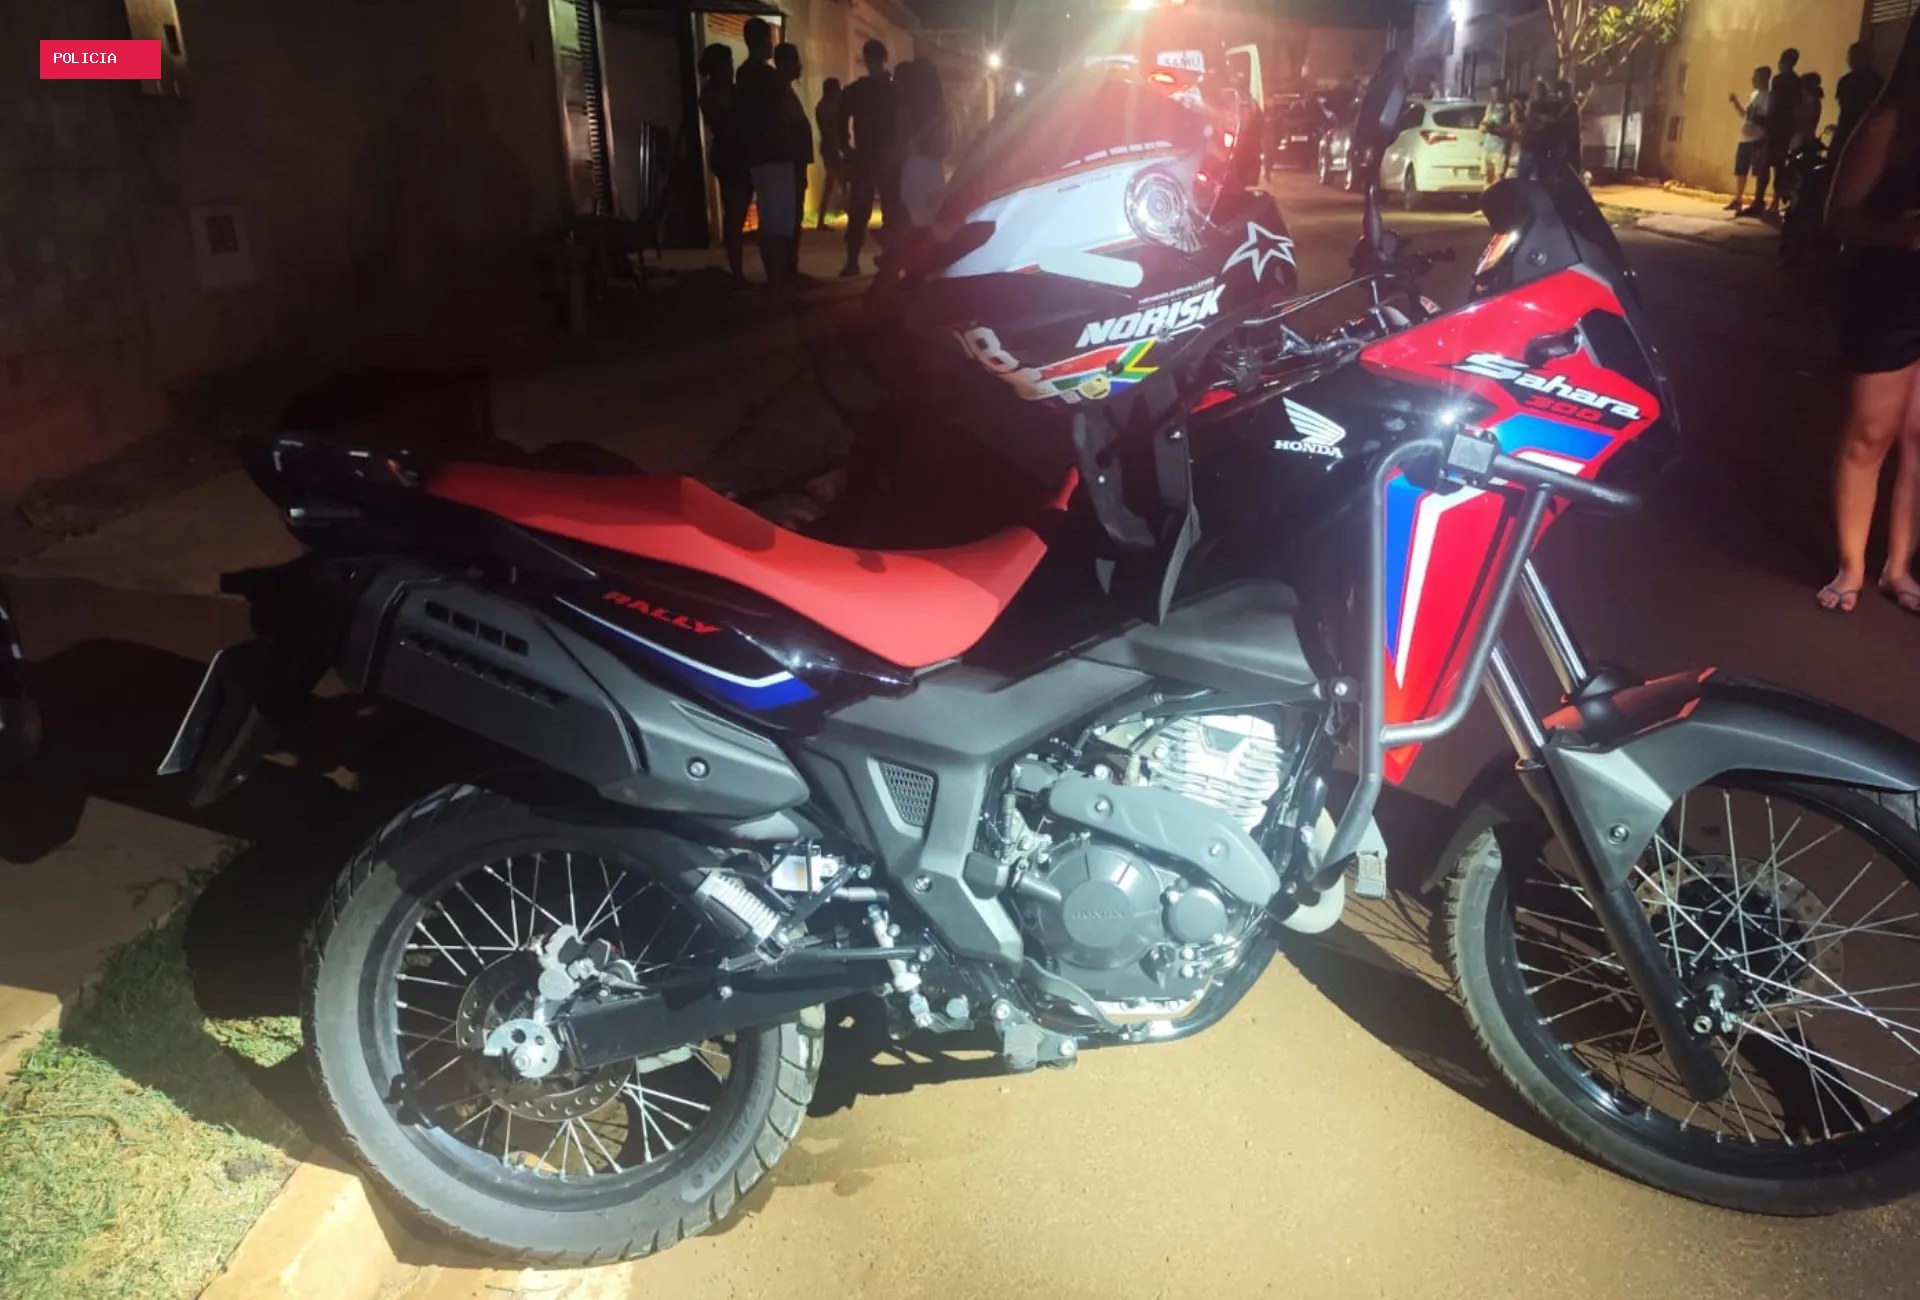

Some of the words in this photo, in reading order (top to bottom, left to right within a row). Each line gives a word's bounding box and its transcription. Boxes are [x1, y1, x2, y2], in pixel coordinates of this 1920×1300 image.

[1075, 283, 1226, 348] NORISK
[1452, 353, 1642, 420] Sahara
[1525, 394, 1603, 422] 300
[1274, 440, 1344, 459] HONDA
[602, 591, 721, 634] RALLY
